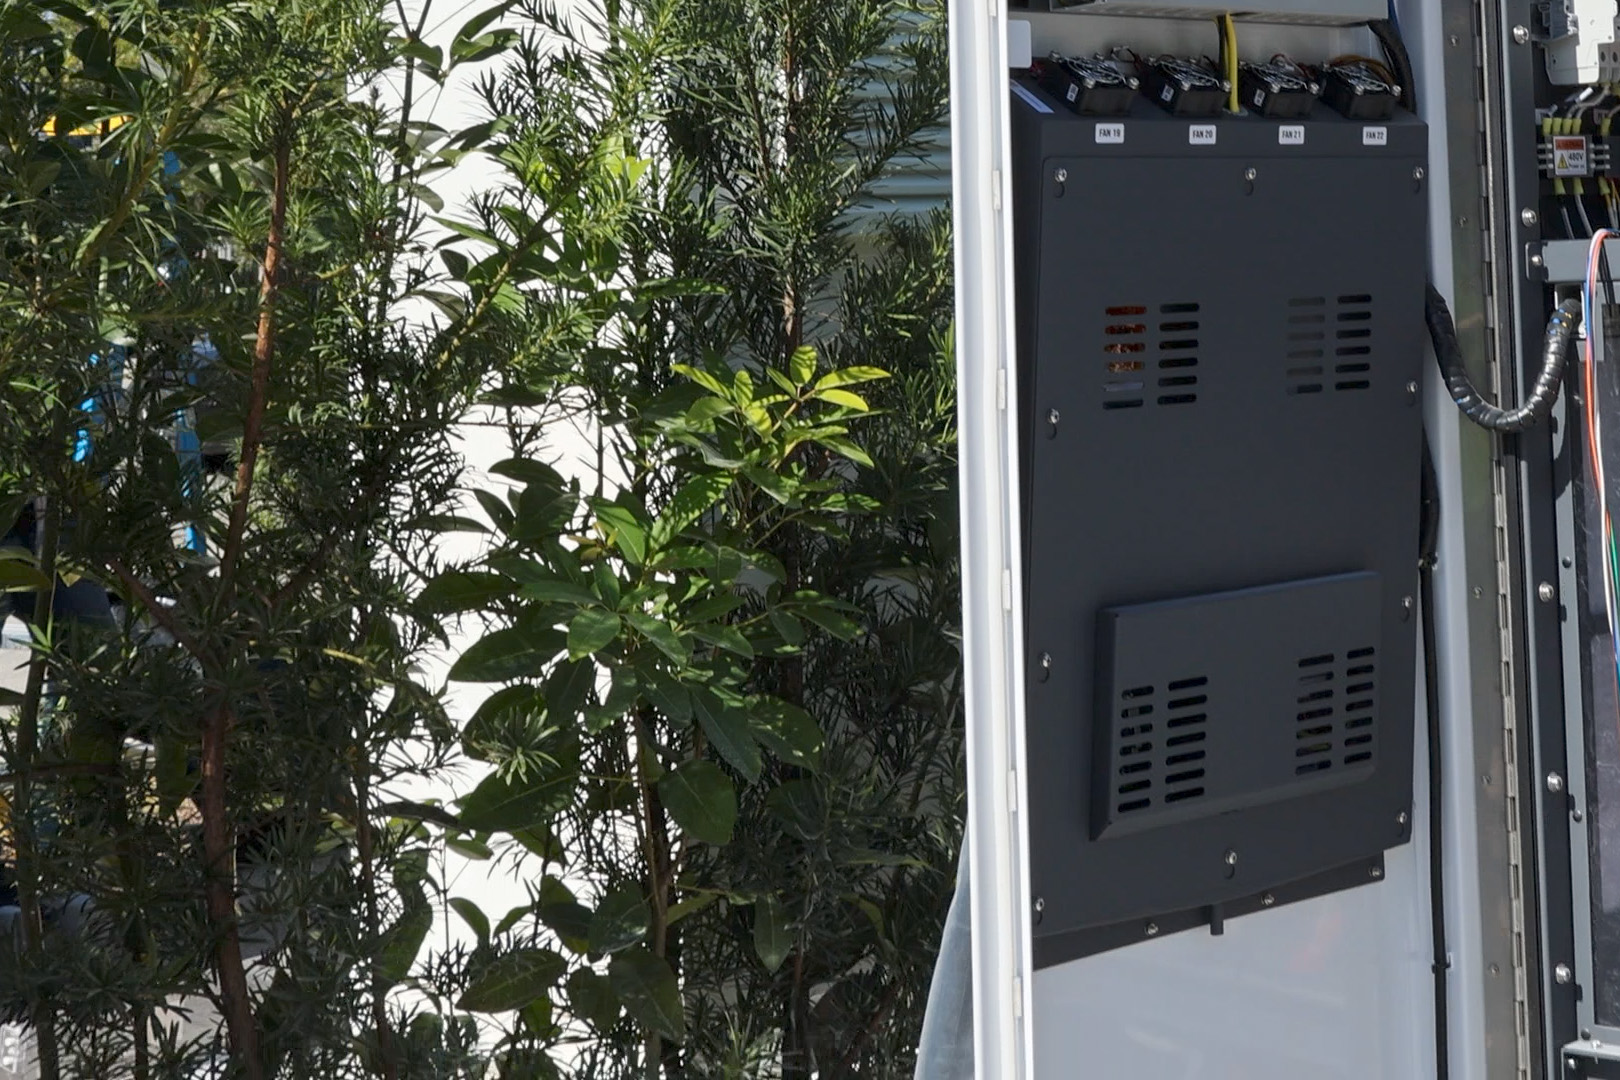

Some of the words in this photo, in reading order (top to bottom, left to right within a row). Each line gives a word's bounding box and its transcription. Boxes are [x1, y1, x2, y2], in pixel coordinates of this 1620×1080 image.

[1099, 128, 1111, 138] FAN
[1113, 128, 1121, 138] 19
[1192, 130, 1204, 138] FAN
[1205, 130, 1213, 138] 20
[1282, 130, 1292, 139] FAN
[1294, 130, 1301, 139] 21
[1365, 131, 1376, 140] FAN
[1376, 131, 1384, 140] 22
[1568, 152, 1584, 161] 480V
